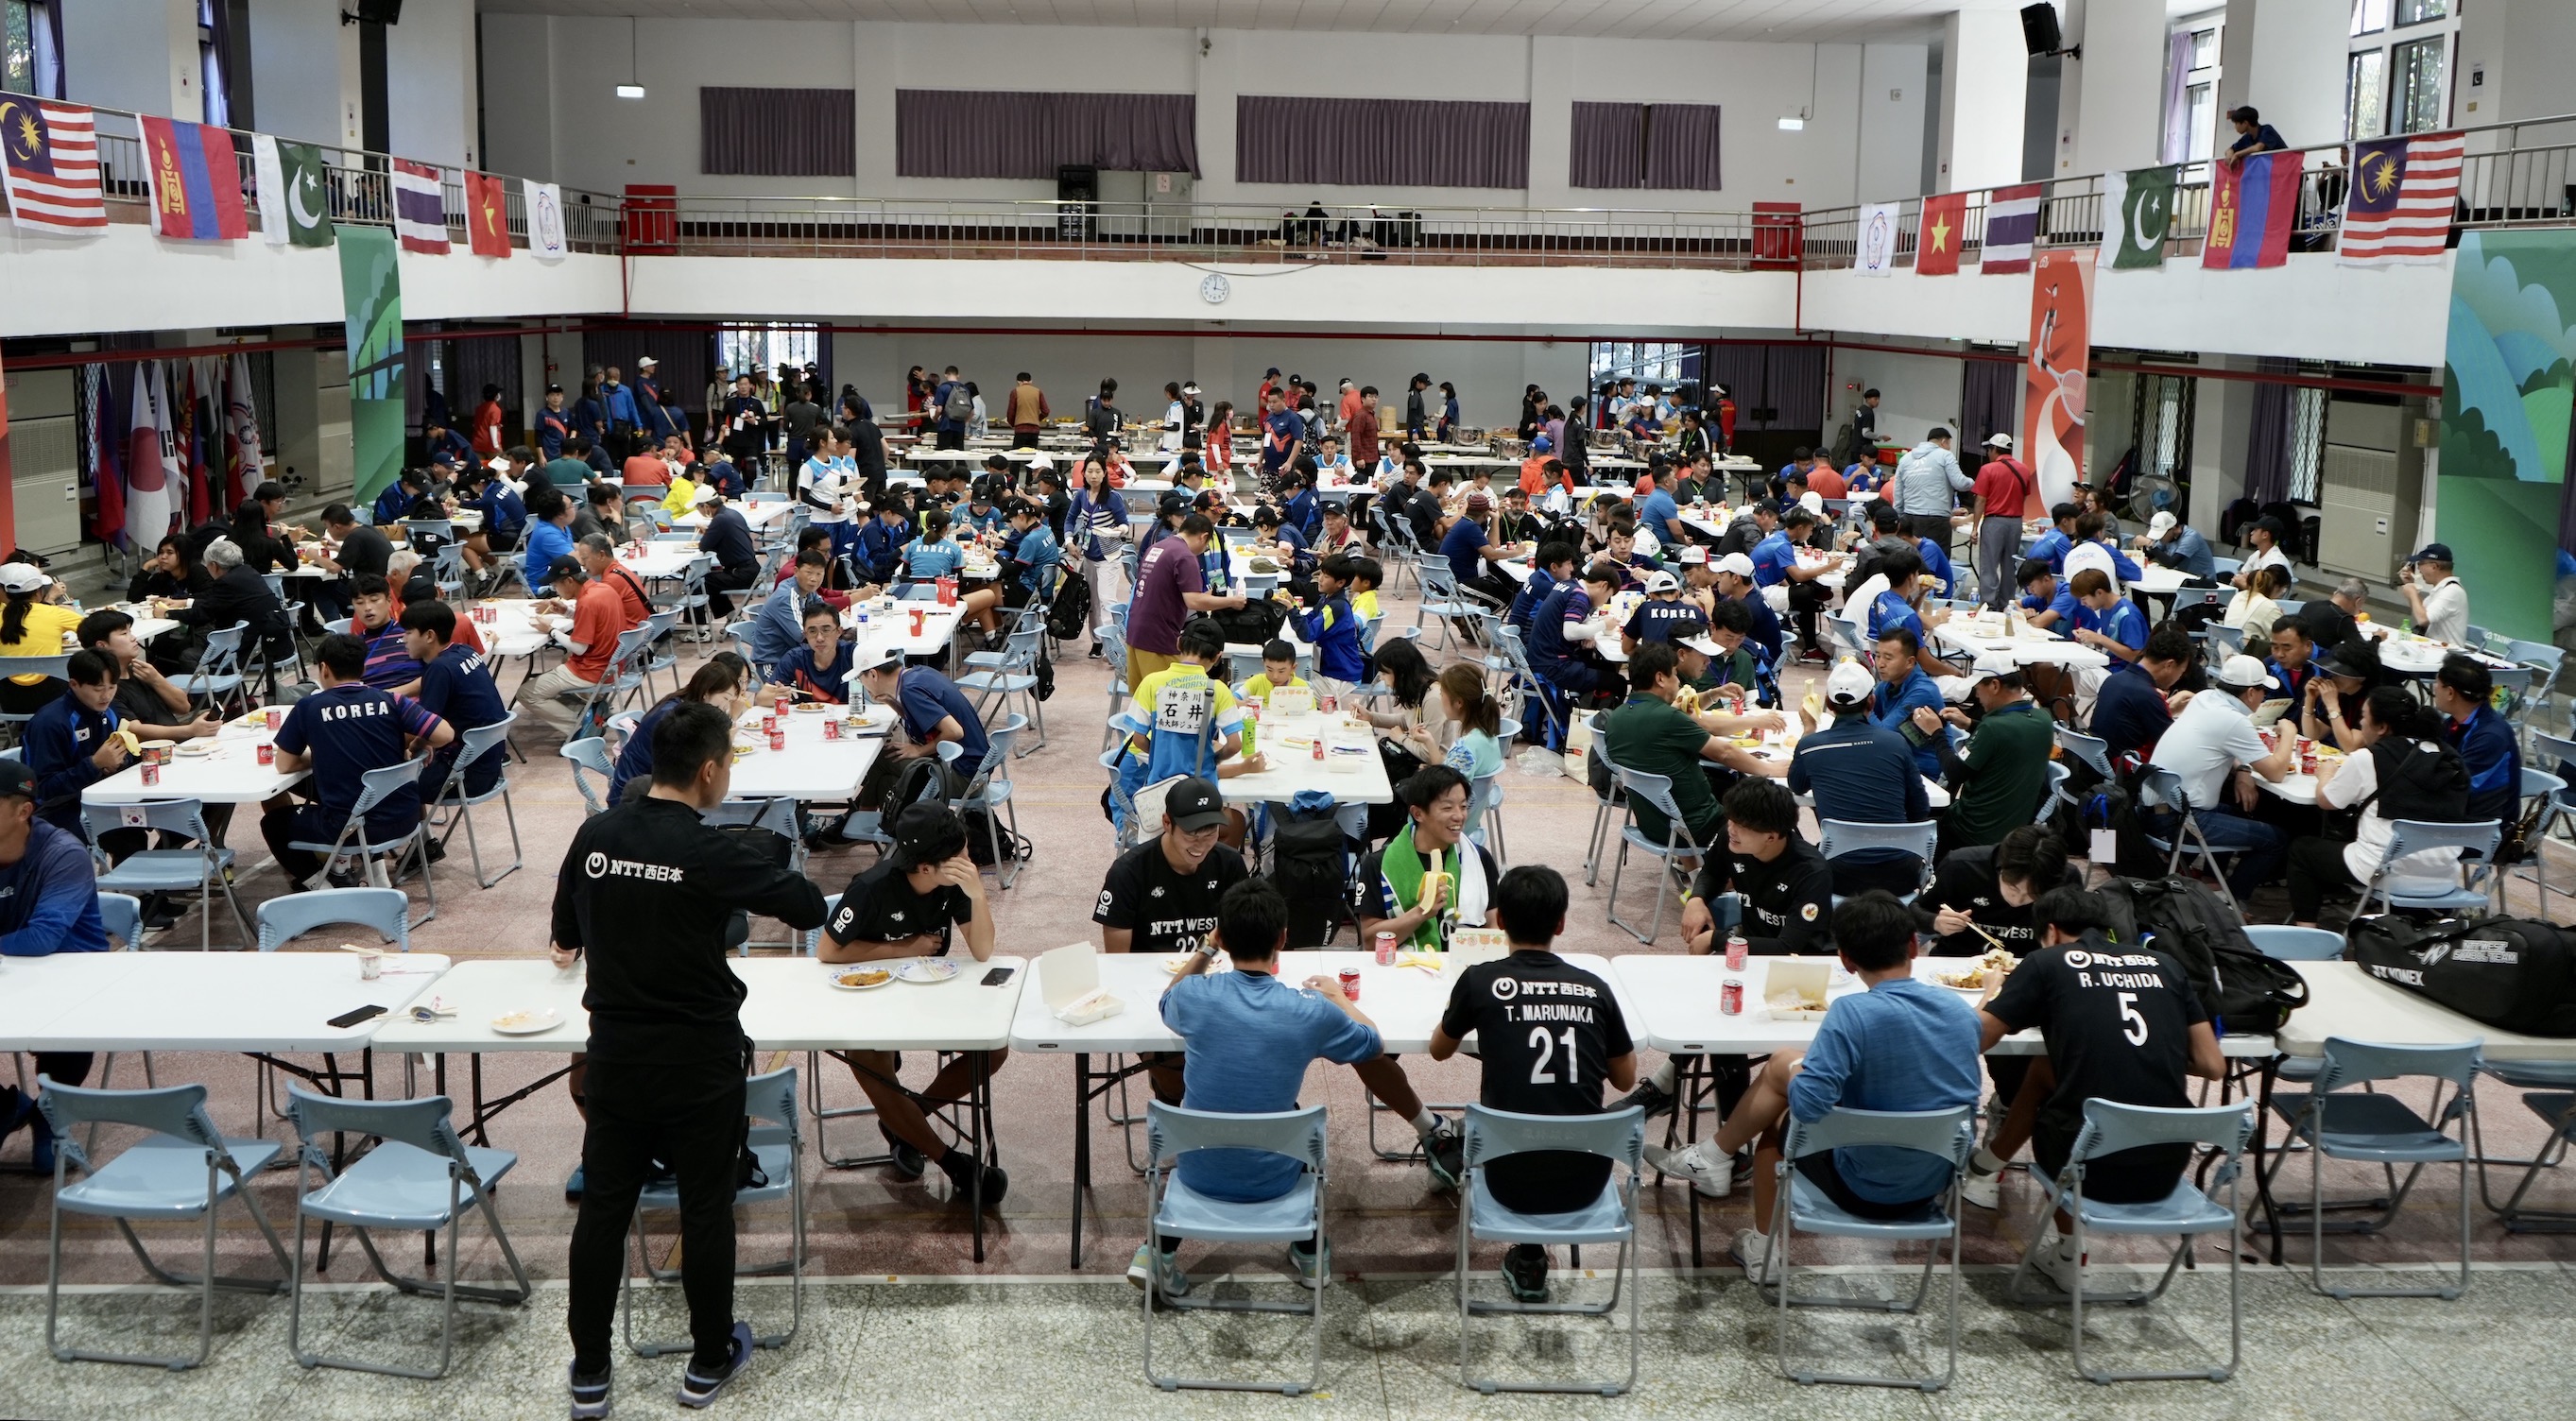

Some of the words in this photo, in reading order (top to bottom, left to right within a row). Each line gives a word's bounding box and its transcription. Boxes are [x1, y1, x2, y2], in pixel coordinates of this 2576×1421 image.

[916, 544, 952, 555] KOREA
[1650, 608, 1697, 620] KOREA
[2493, 633, 2516, 644] TAIWA
[1168, 691, 1201, 702] 神奈川
[321, 701, 389, 722] KOREA
[1757, 907, 1787, 927] WEST
[1150, 919, 1184, 935] NTT
[1976, 922, 2008, 936] TT
[2482, 940, 2508, 951] WEST
[2488, 951, 2518, 964] TEAM
[2387, 967, 2425, 987] YONEX
[2118, 992, 2148, 1047] 5
[1529, 1026, 1578, 1084] 21
